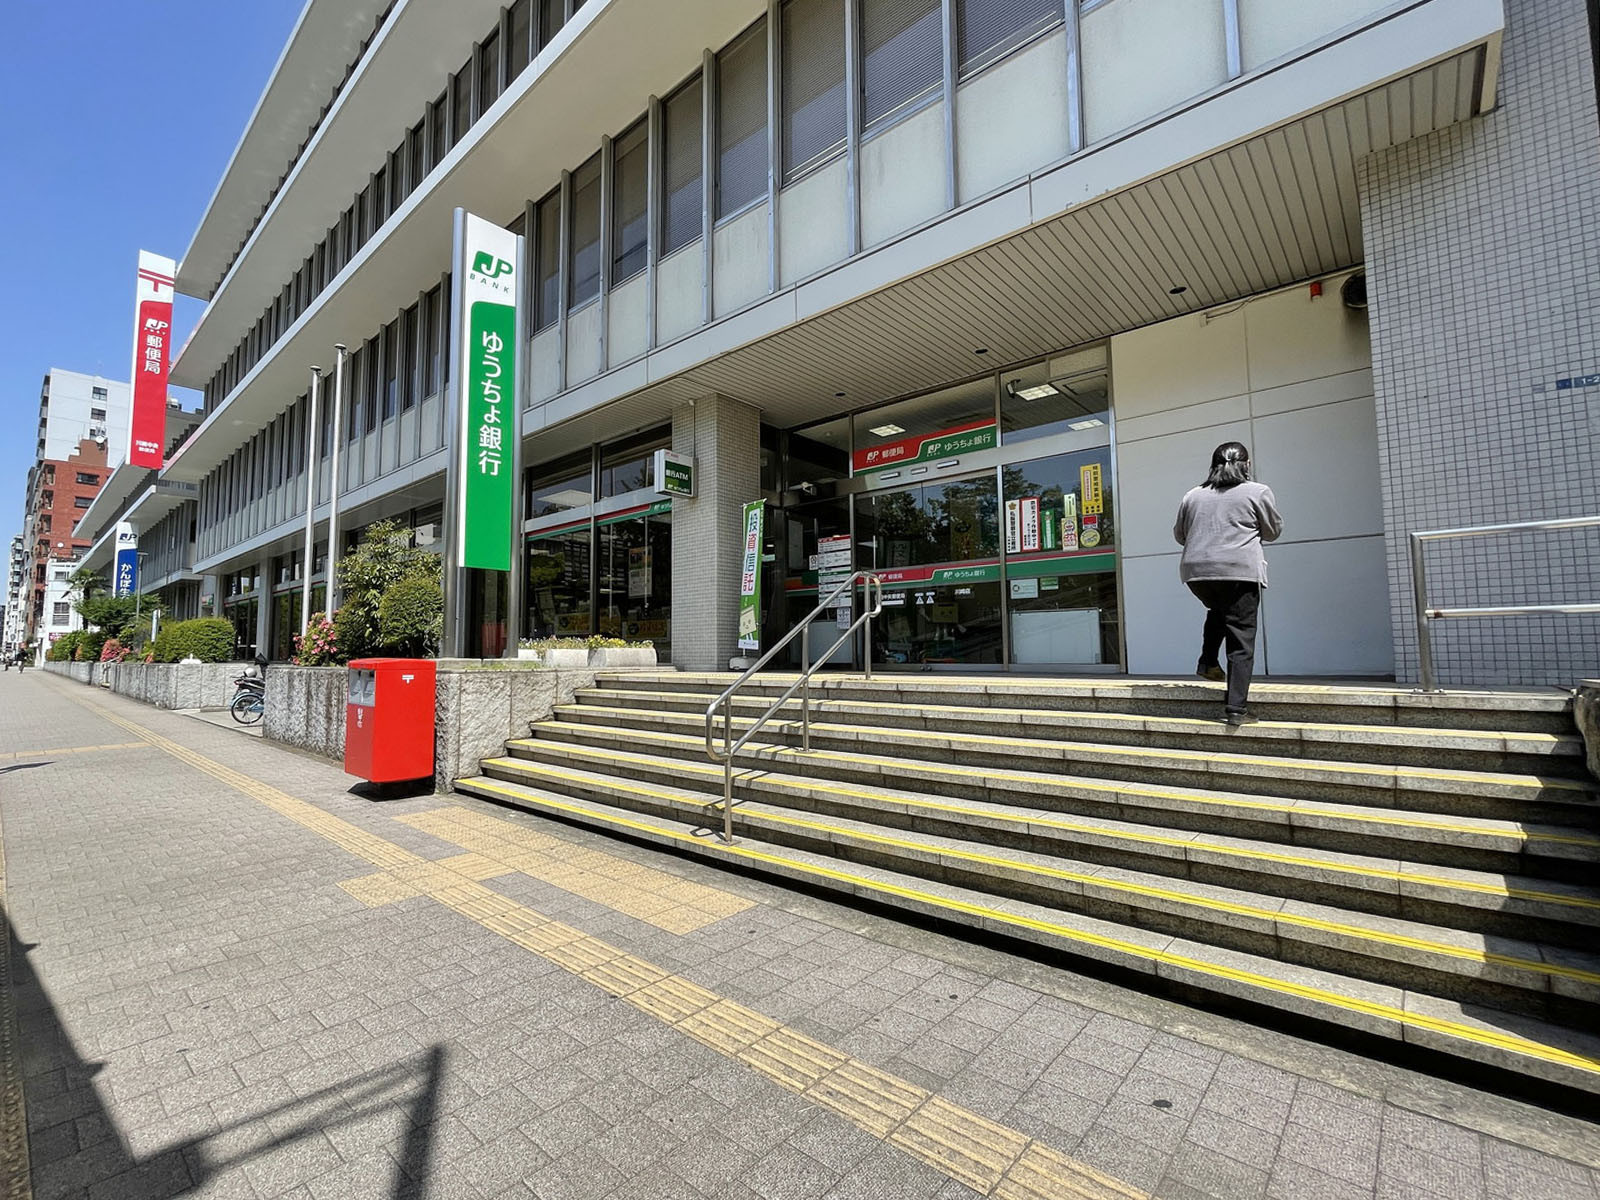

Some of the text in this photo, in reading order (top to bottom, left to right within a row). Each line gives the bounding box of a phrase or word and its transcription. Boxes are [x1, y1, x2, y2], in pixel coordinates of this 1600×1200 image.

[472, 250, 513, 279] JP
[470, 273, 510, 293] BANK
[144, 334, 162, 374] 郵便局
[478, 331, 503, 476] ゆうちょ銀行
[882, 446, 905, 459] 郵便局
[944, 433, 992, 452] ゆうちょ銀行
[120, 563, 132, 599] かんぽ生
[954, 569, 986, 579] ゆうちょ銀行
